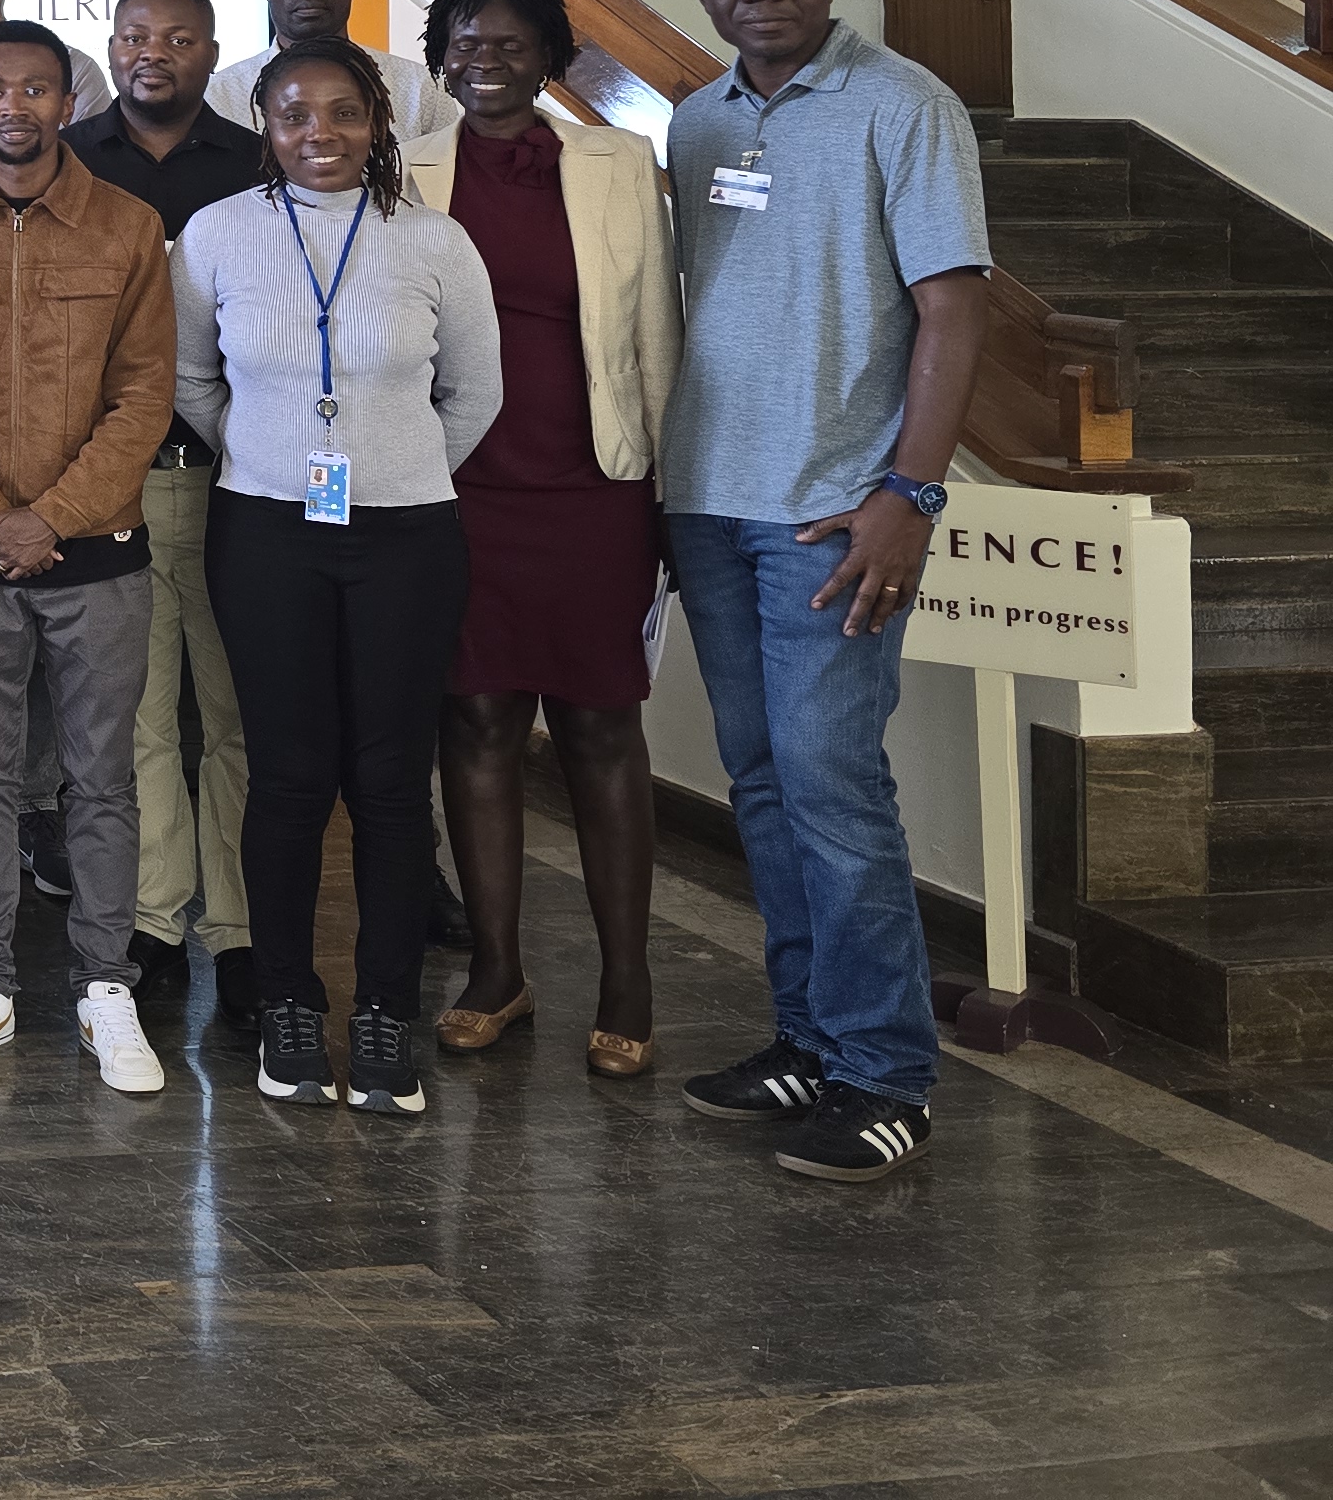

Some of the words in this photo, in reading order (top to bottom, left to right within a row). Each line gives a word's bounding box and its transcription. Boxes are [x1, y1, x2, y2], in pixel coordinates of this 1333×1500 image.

[928, 528, 1124, 576] ENCE!
[913, 591, 960, 621] ing
[970, 596, 995, 619] in
[1006, 606, 1129, 633] progress
